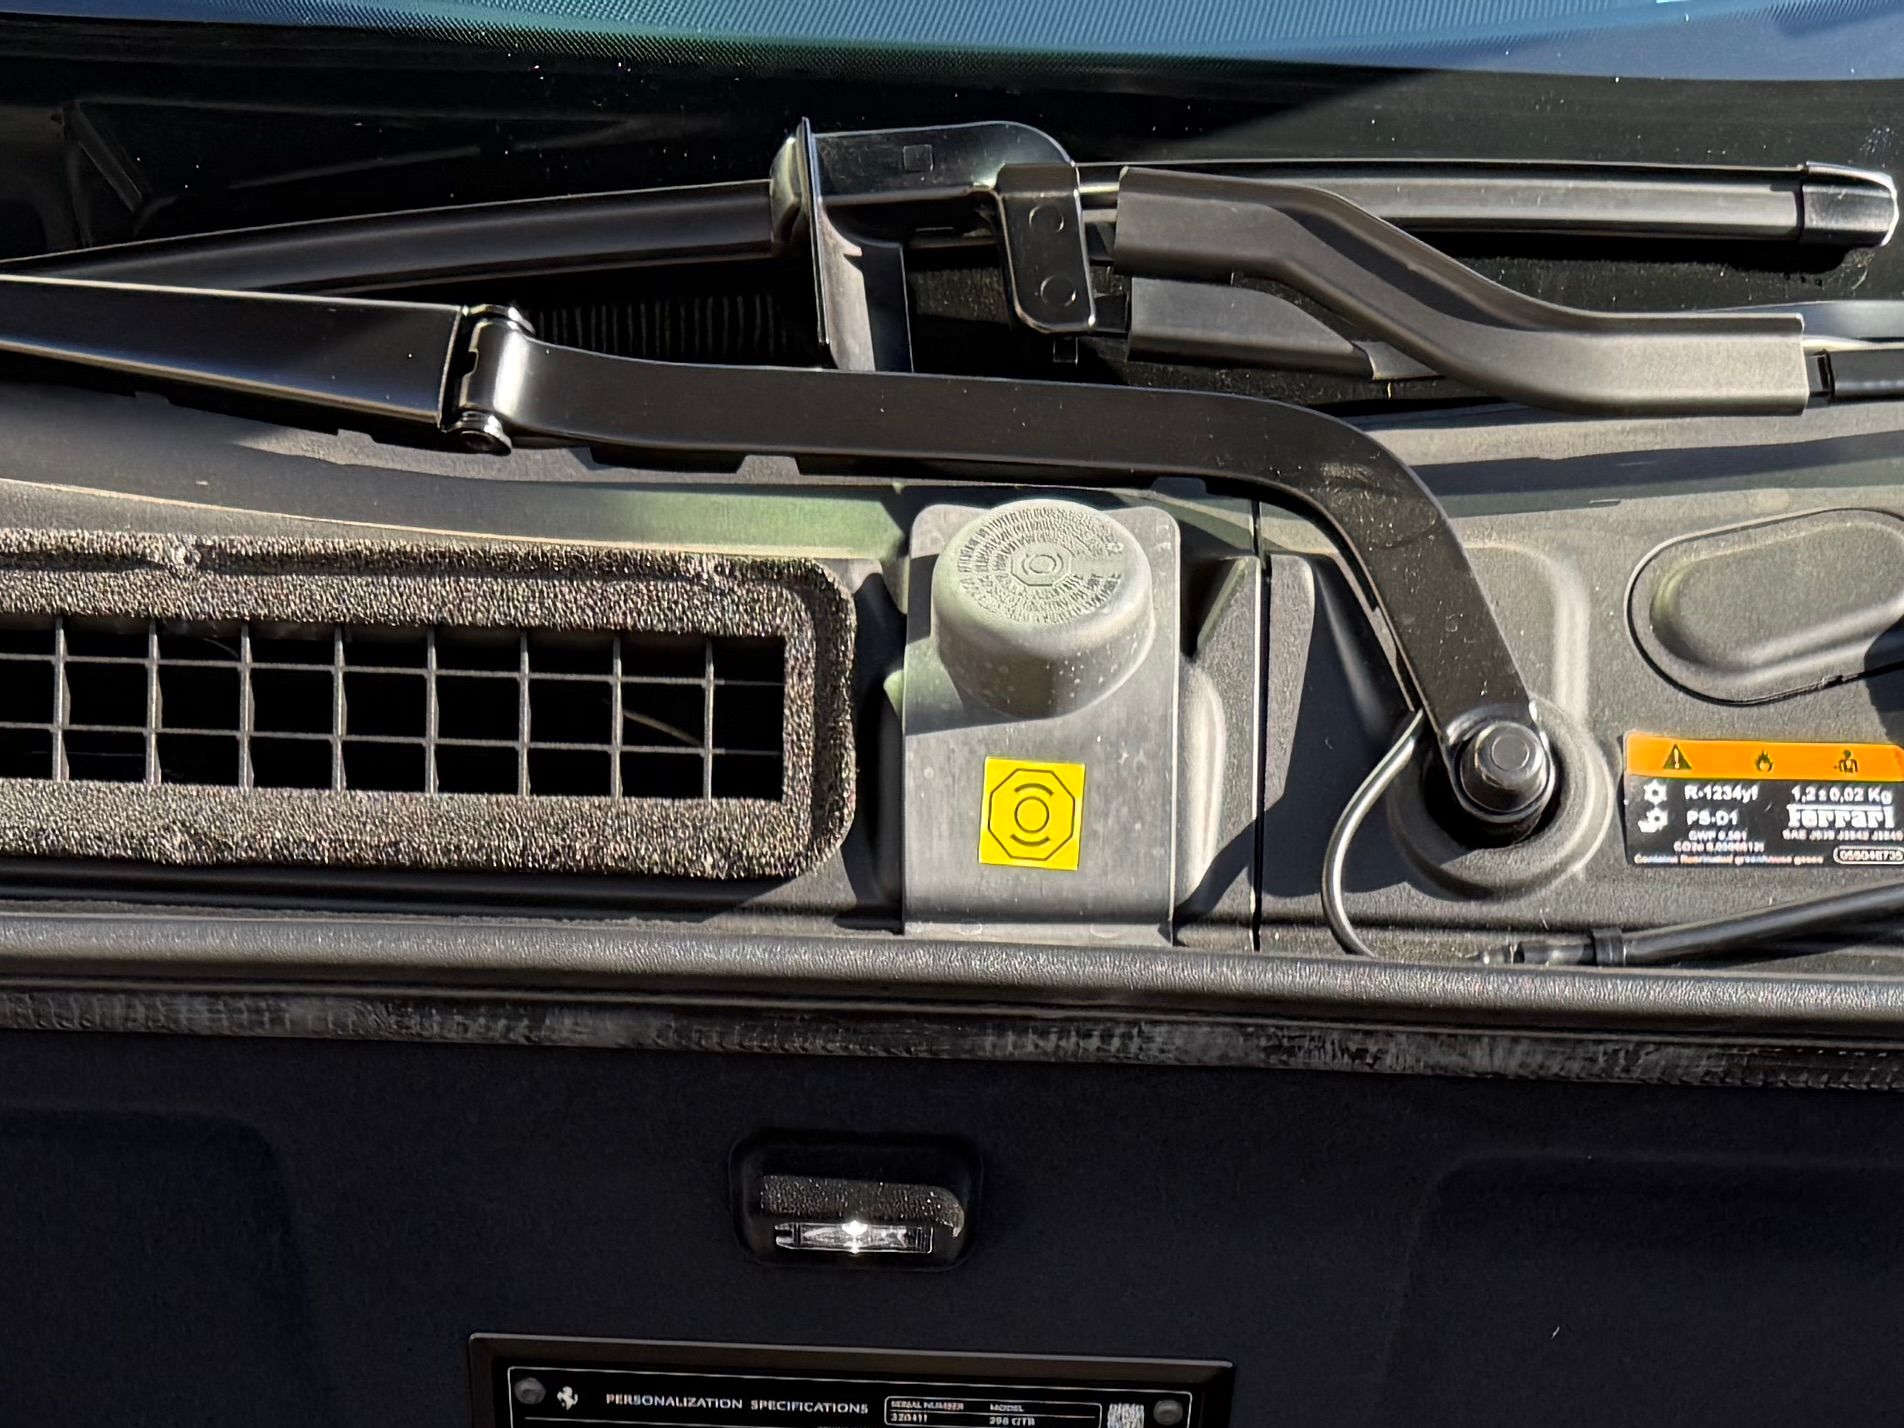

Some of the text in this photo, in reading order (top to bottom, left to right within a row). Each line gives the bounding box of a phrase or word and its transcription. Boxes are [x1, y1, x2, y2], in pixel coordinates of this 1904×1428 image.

[1684, 784, 1760, 804] R-1234yf
[1867, 788, 1894, 805] Kg
[1786, 804, 1896, 829] Ferrari
[605, 1393, 870, 1415] PERSONALIZATION SPECIFICATIONS
